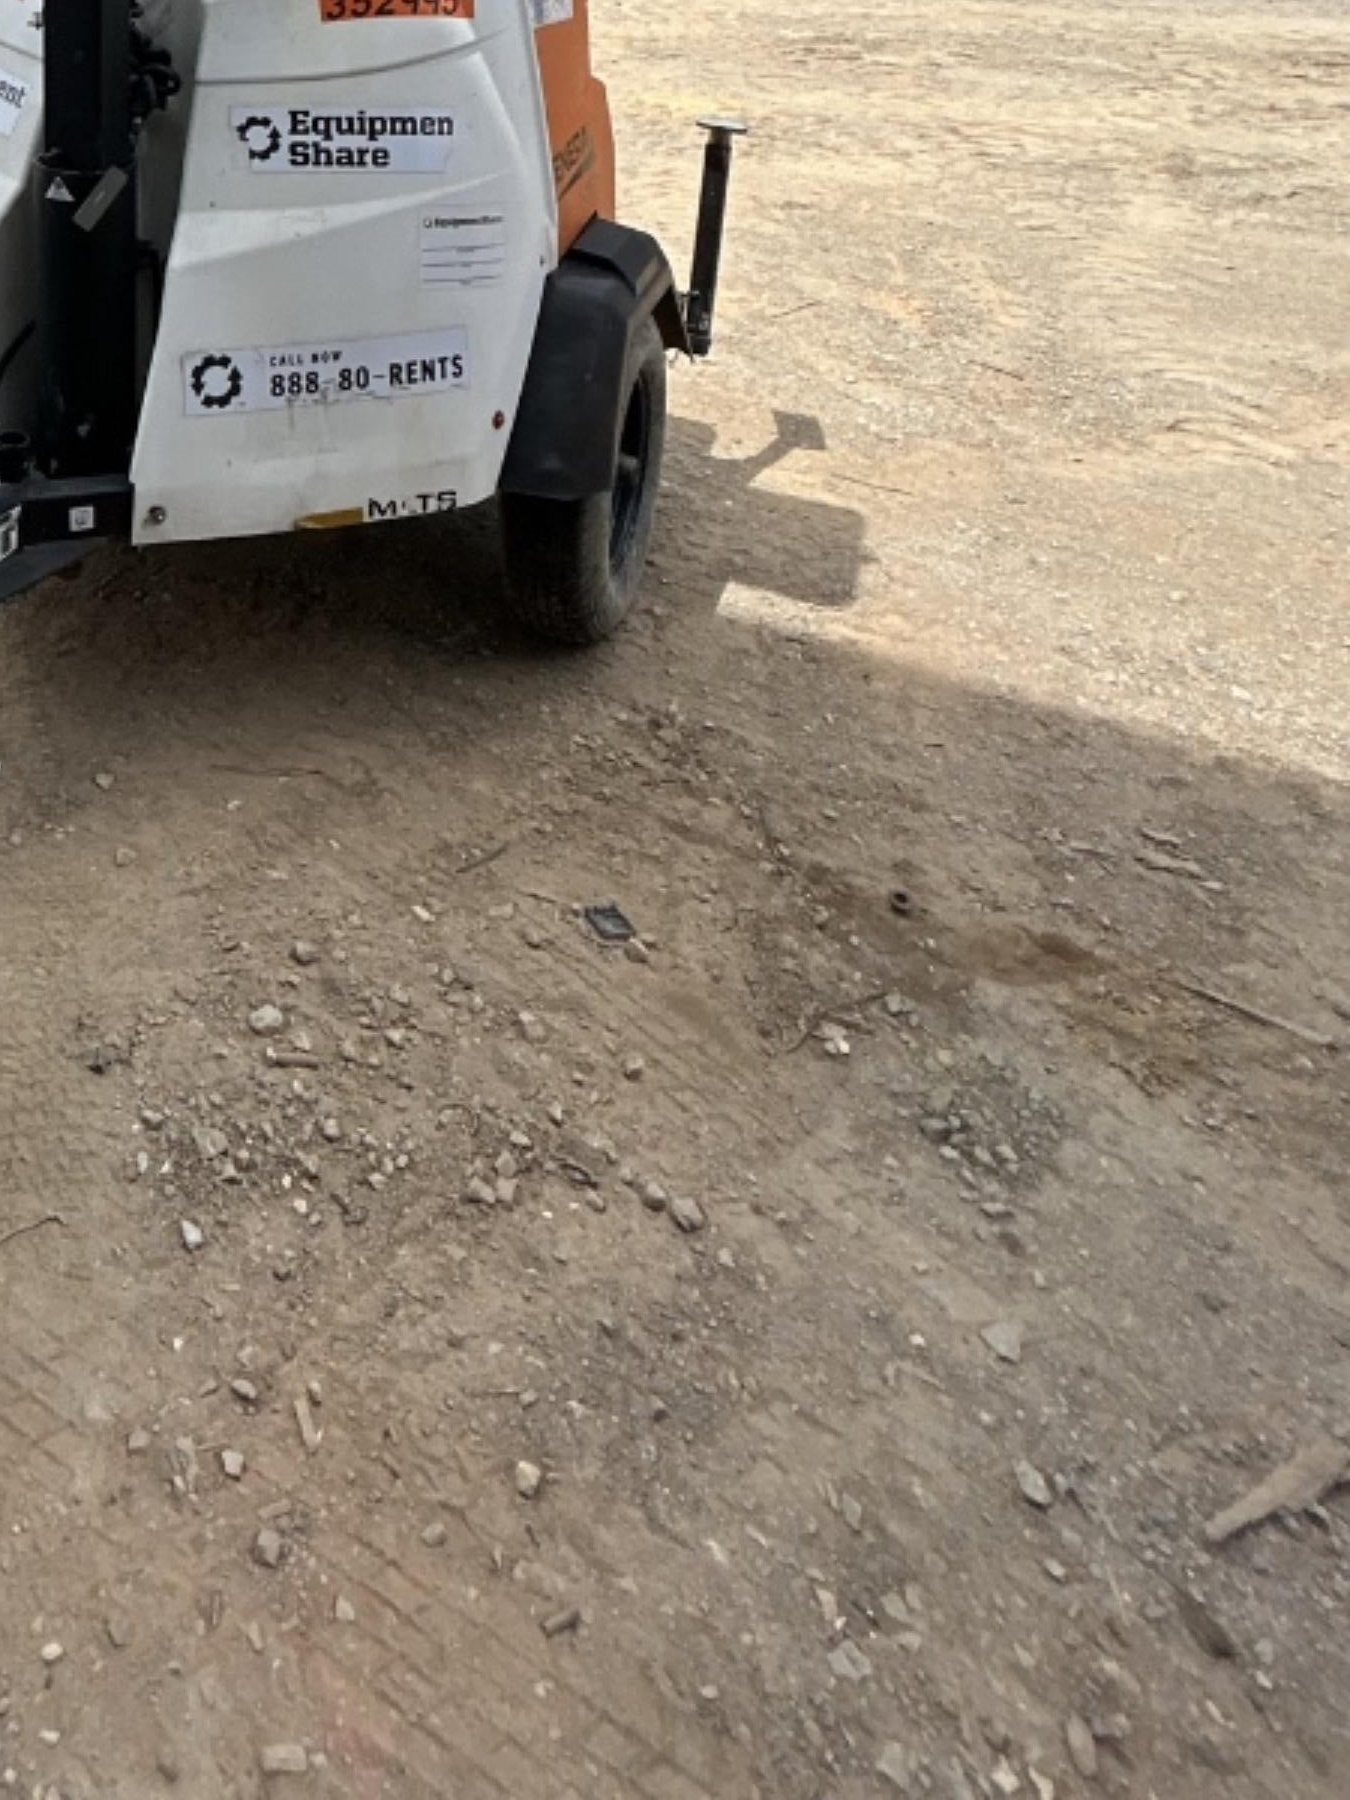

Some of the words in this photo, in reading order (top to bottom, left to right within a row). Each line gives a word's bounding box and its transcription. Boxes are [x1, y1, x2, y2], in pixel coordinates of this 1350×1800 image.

[287, 141, 391, 167] Share
[269, 353, 304, 368] CALL
[311, 350, 343, 365] NOW
